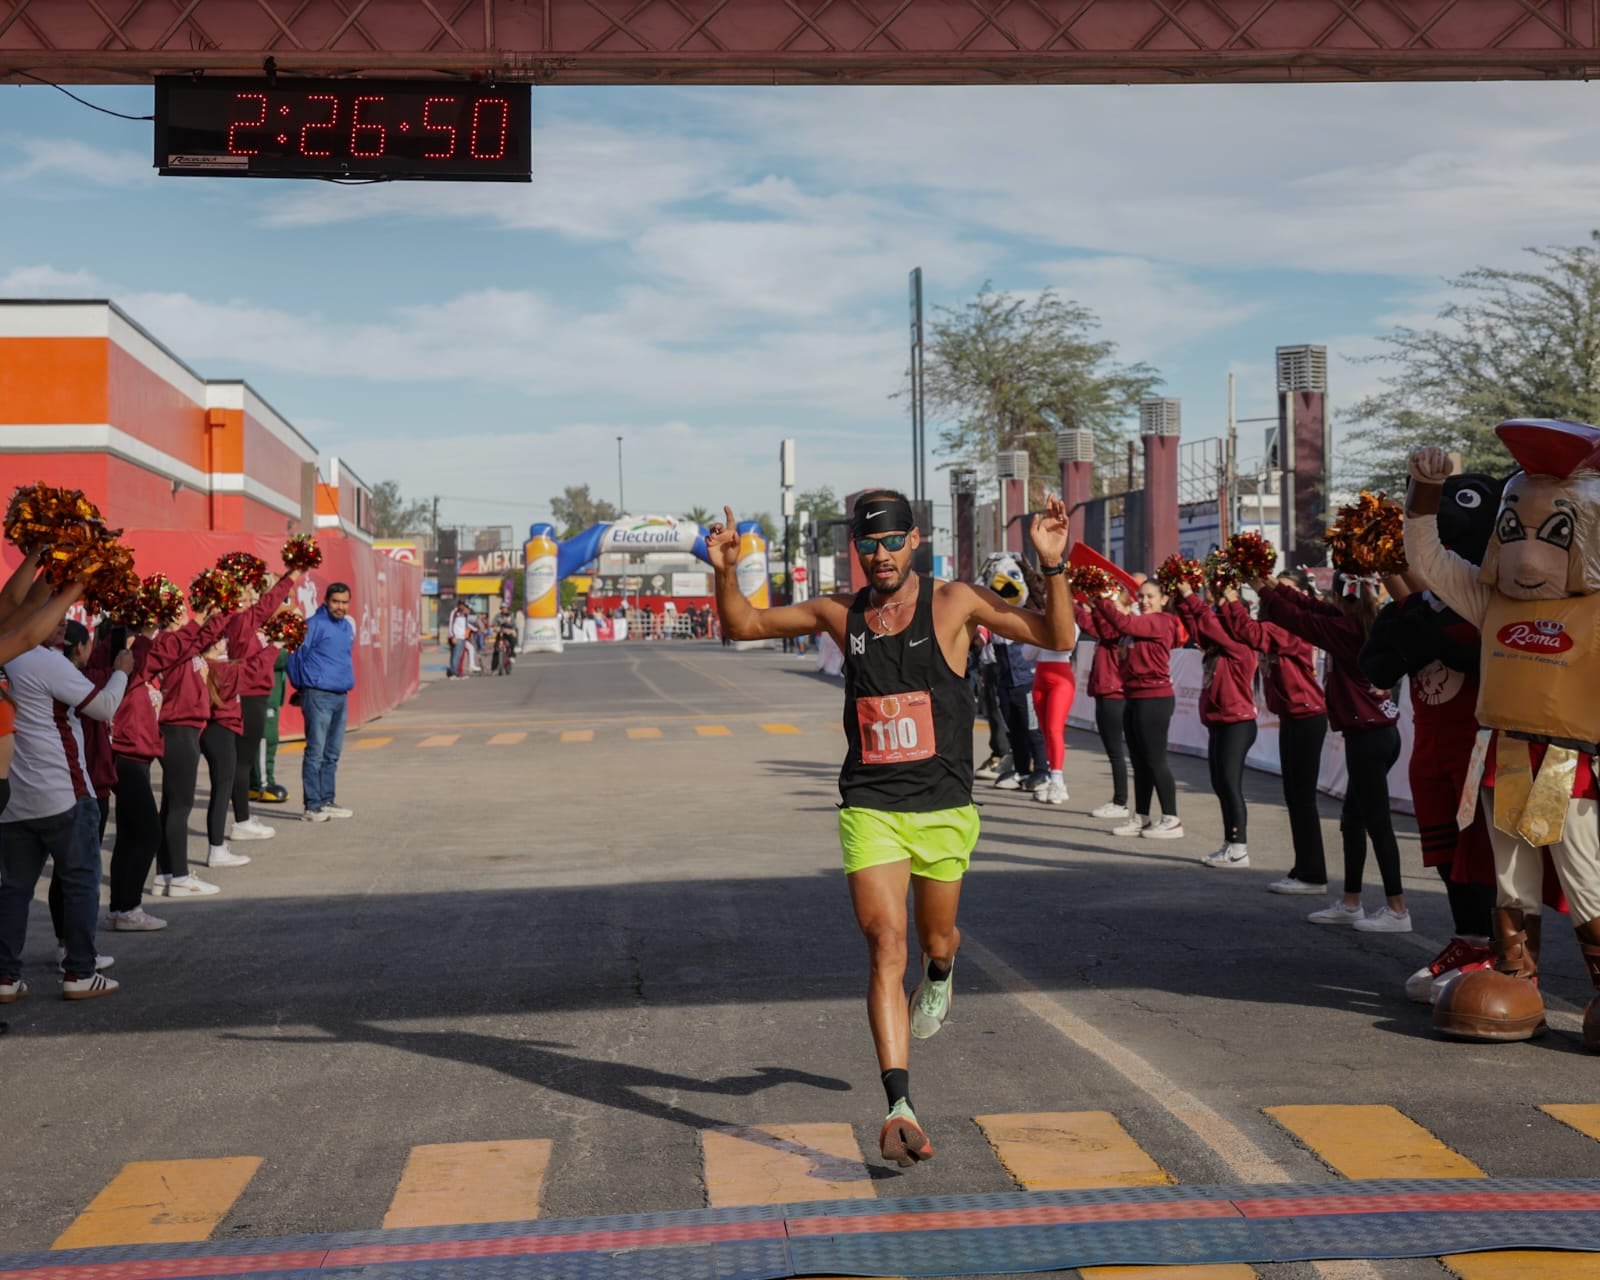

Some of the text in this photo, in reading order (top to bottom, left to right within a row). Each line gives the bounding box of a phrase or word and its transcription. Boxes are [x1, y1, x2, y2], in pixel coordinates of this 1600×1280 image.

[612, 529, 681, 543] Electrolit
[1504, 624, 1561, 648] Roma
[871, 717, 918, 751] 110
